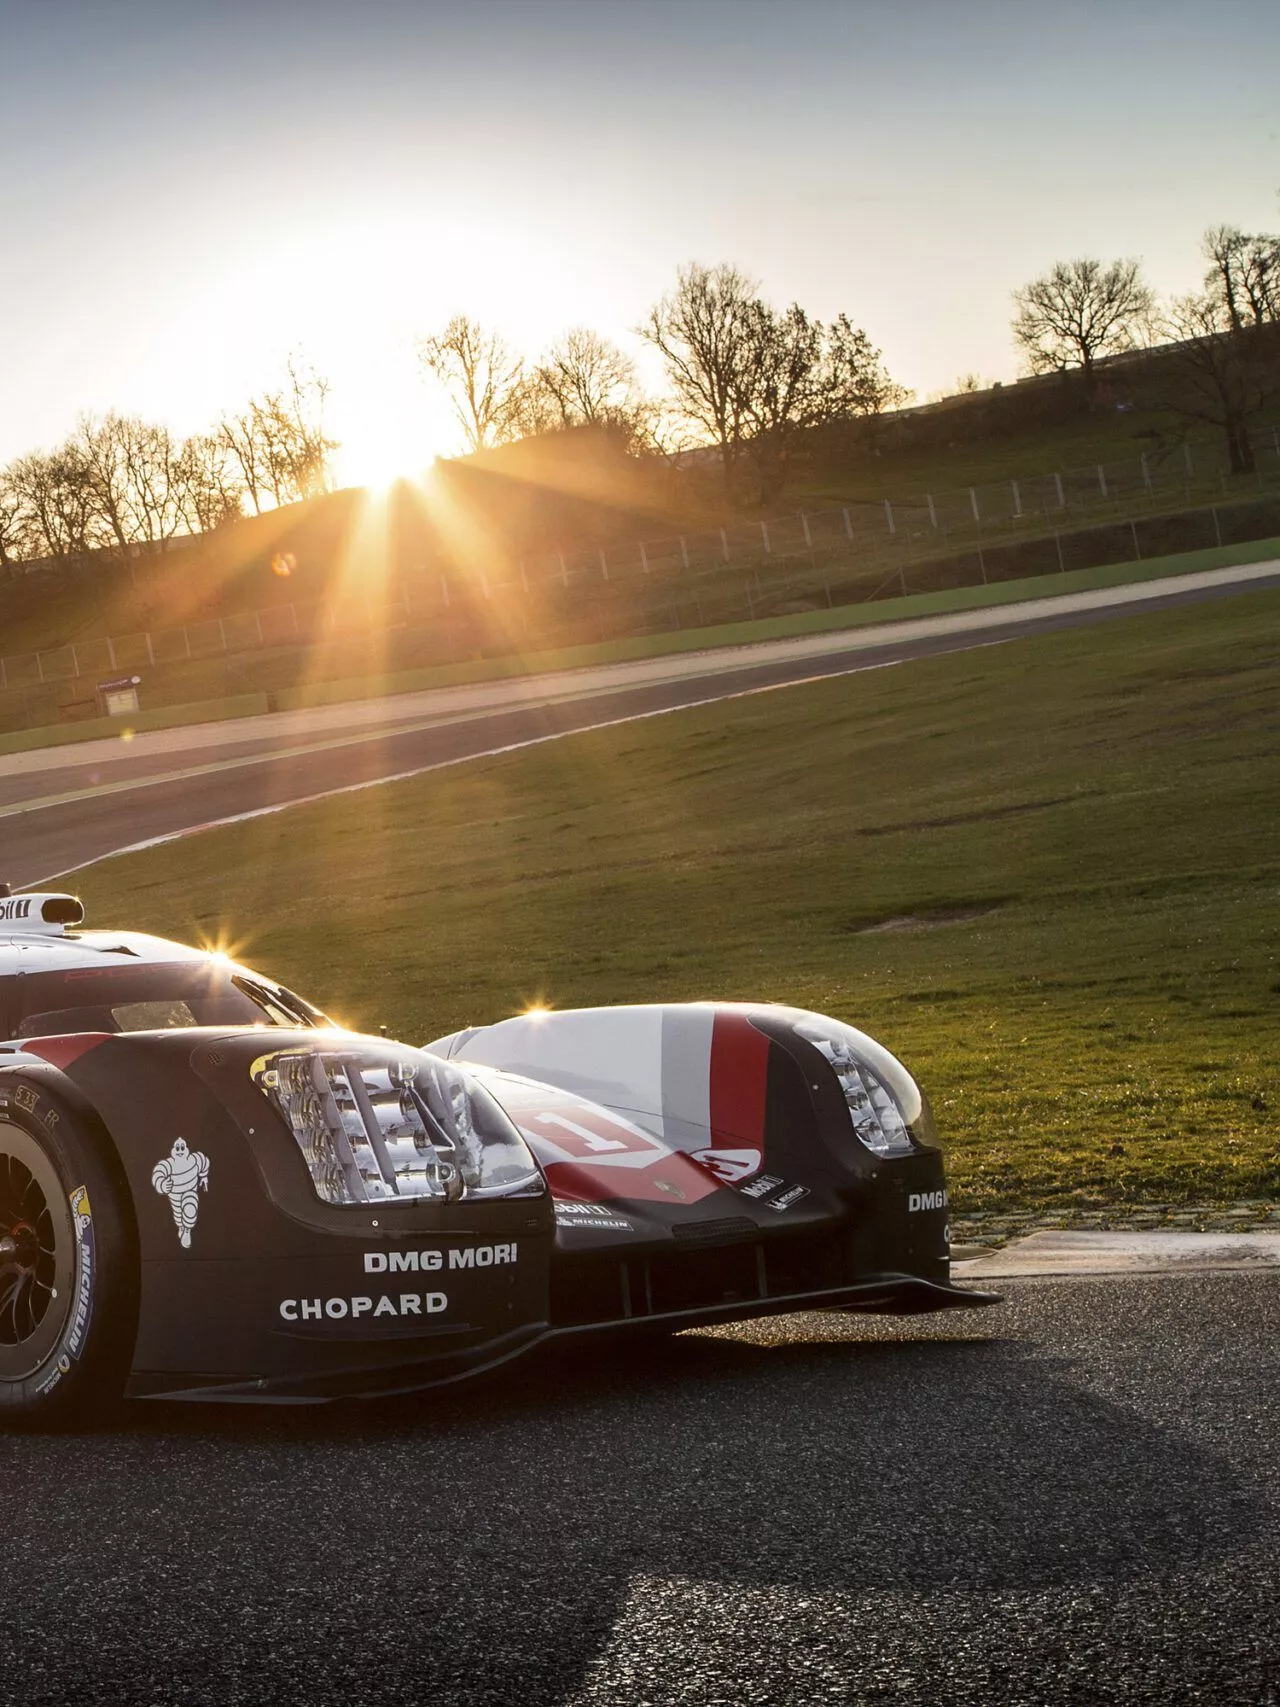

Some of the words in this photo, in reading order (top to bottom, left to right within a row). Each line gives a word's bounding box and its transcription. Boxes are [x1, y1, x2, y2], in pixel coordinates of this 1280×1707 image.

[535, 1111, 629, 1152] 1
[908, 1191, 942, 1212] DMG
[572, 1219, 627, 1228] MICHELIN
[364, 1250, 443, 1273] DMG
[449, 1243, 518, 1270] MORI
[69, 1243, 91, 1352] MICHELIN
[280, 1291, 448, 1321] CHOPARD
